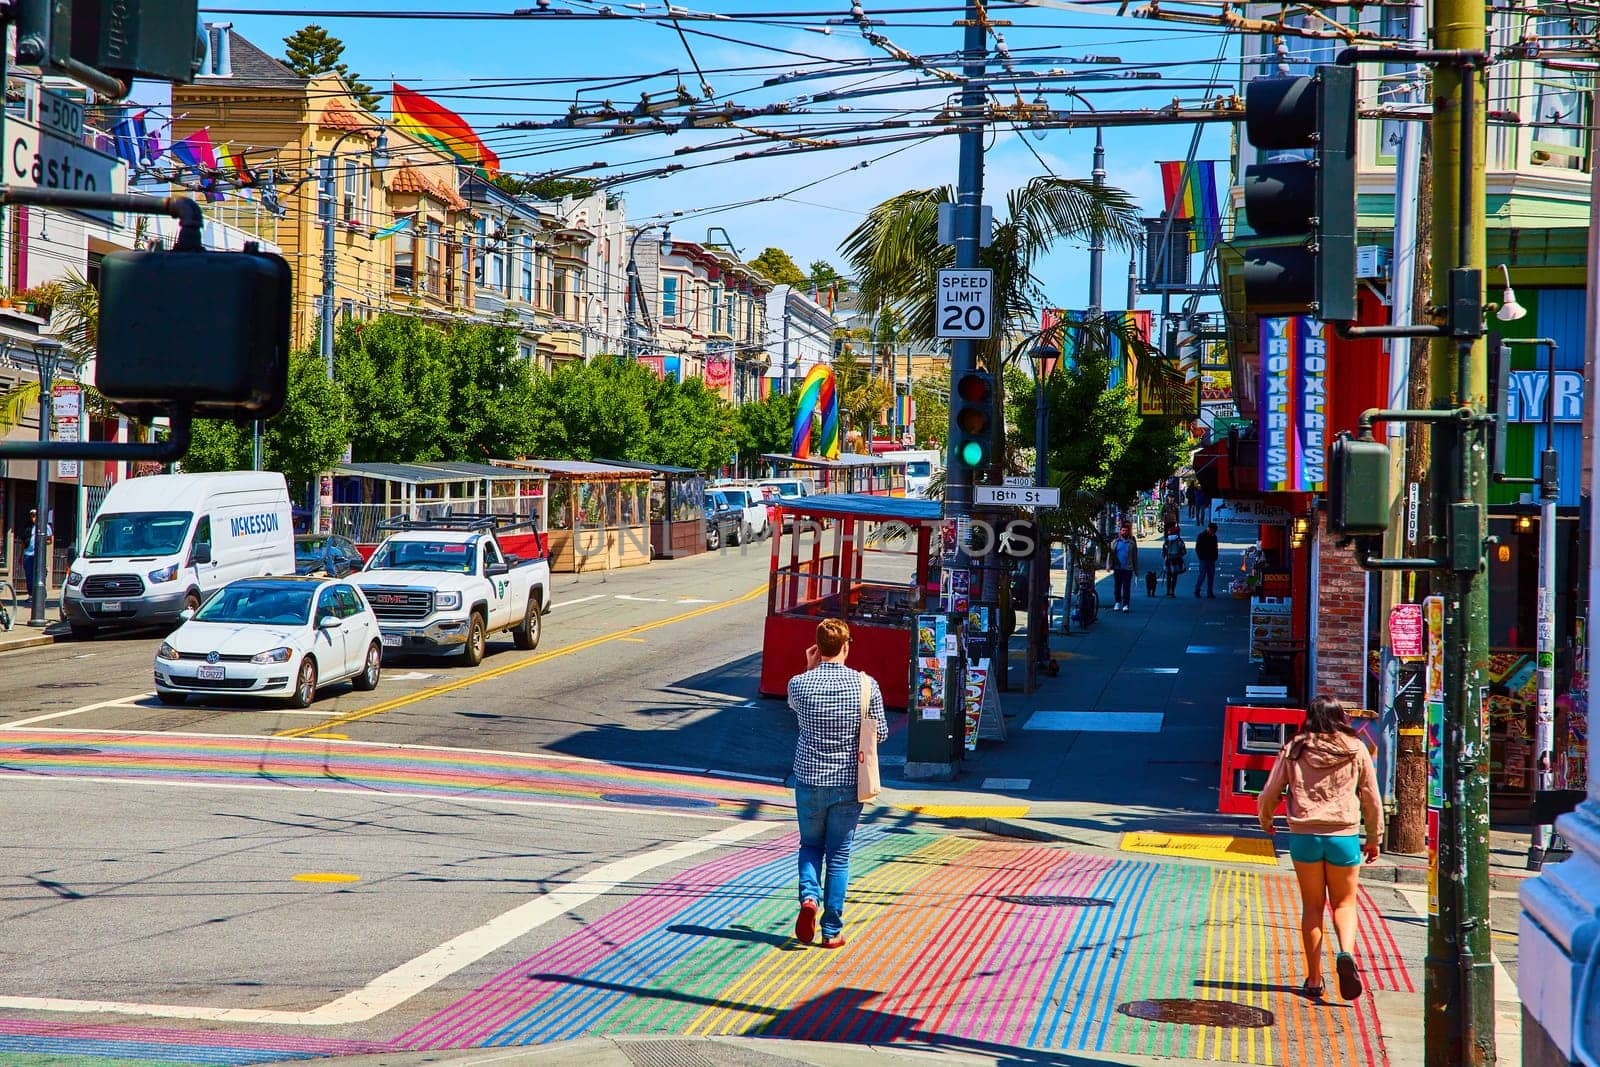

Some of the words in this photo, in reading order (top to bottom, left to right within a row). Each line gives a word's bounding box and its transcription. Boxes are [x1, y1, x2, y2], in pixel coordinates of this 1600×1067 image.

[52, 100, 80, 134] 500
[13, 137, 97, 192] Castro
[942, 277, 988, 288] SPEED
[946, 291, 982, 302] LIMIT
[942, 305, 985, 331] 20
[1012, 478, 1029, 486] 4100
[991, 490, 1017, 501] 18th
[1025, 491, 1041, 502] St
